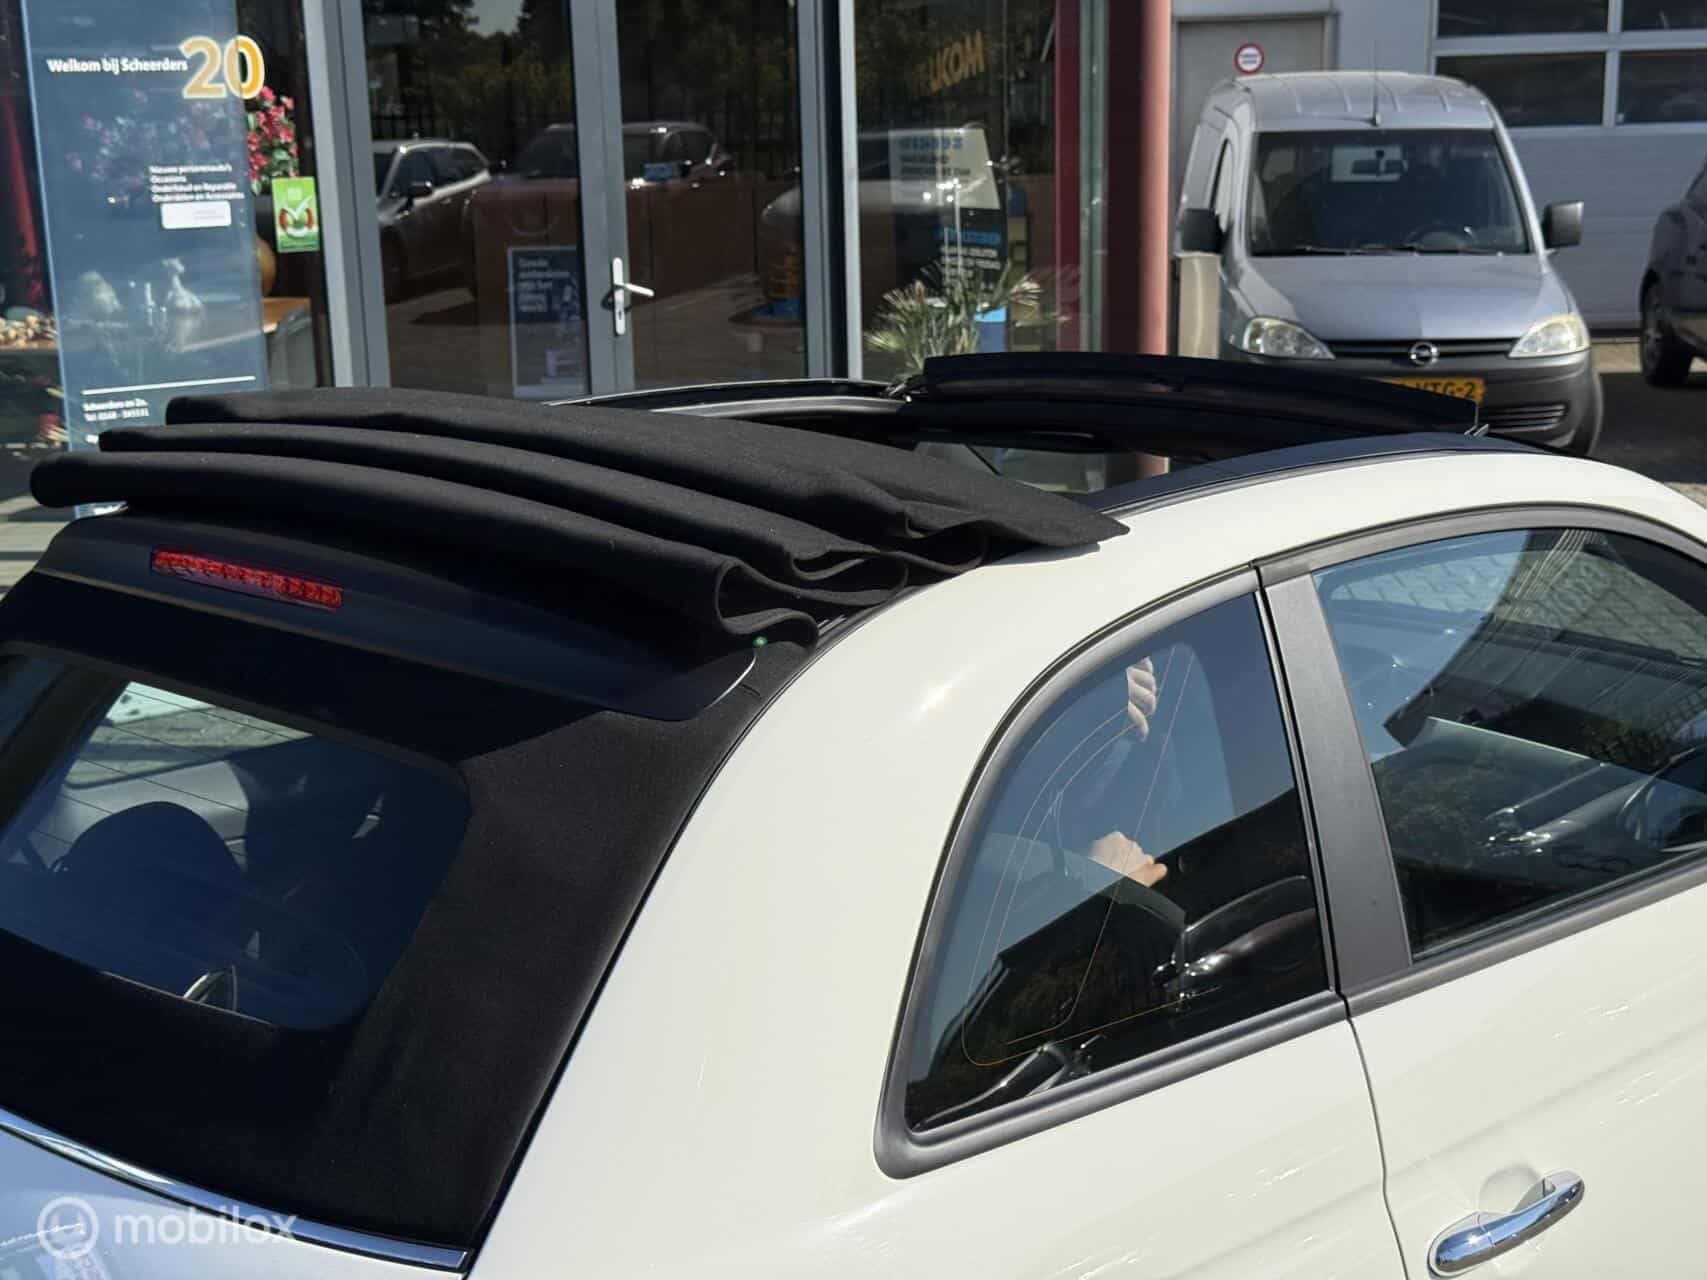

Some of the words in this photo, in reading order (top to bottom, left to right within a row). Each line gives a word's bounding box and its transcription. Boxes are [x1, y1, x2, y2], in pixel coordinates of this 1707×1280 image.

[46, 58, 101, 73] Welkom
[102, 57, 120, 75] bij
[120, 57, 188, 72] Scheerders
[178, 35, 265, 99] 20
